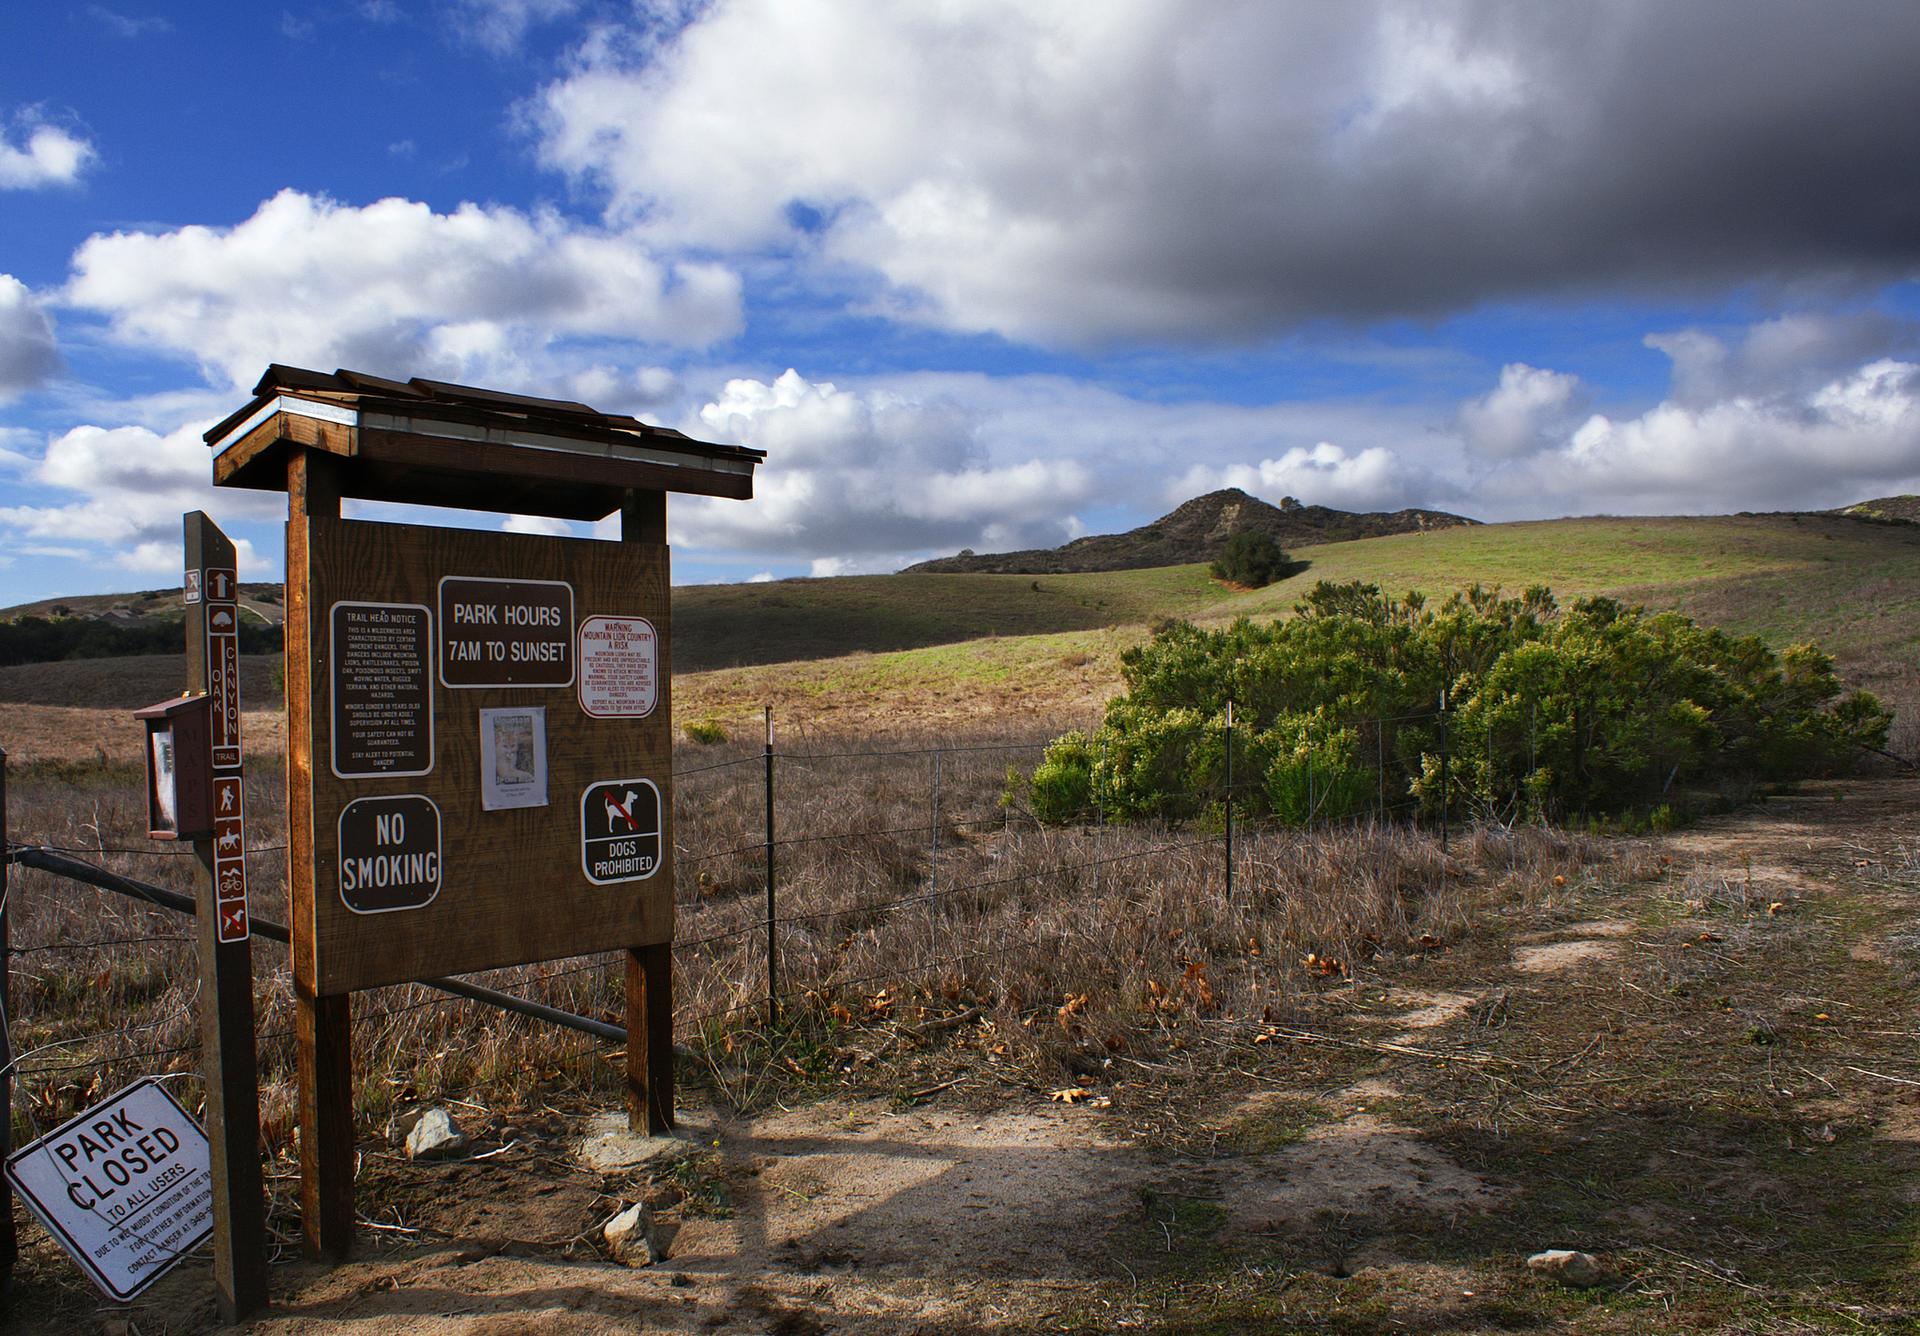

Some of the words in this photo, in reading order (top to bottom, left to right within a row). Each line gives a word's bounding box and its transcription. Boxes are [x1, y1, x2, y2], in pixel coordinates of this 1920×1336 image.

[347, 612, 368, 623] TRAIL
[369, 613, 390, 624] HEAD
[390, 614, 417, 625] NOTICE
[454, 603, 498, 625] PARK
[505, 605, 561, 627] HOURS
[605, 623, 632, 632] WARNING
[449, 641, 481, 661] 7AM
[486, 641, 505, 661] TO
[510, 641, 567, 662] SUNSET
[584, 631, 612, 640] MOUNTAIN
[613, 632, 626, 640] LION
[627, 632, 651, 642] COUNTRY
[608, 641, 614, 649] A
[615, 641, 629, 649] RISK
[212, 669, 222, 712] OAK
[226, 646, 238, 735] CANYON
[215, 752, 237, 761] TRAIL
[377, 812, 405, 846] NO
[594, 856, 653, 877] PROHIBITED
[609, 841, 637, 858] DOGS
[343, 851, 438, 890] SMOKING
[54, 1107, 144, 1172] PARK
[67, 1127, 180, 1210] CLOSED
[107, 1204, 126, 1220] TO
[126, 1189, 151, 1209] ALL
[147, 1163, 186, 1192] USERS
[94, 1244, 111, 1258] DUE
[108, 1237, 120, 1248] TO
[130, 1212, 153, 1232] MUDDY
[152, 1191, 184, 1217] CONDITION
[181, 1184, 192, 1196] OF
[190, 1177, 203, 1189] THE
[129, 1238, 145, 1252] FOR
[143, 1217, 174, 1240] FURTHER
[127, 1248, 158, 1274] CONTACT
[181, 1223, 192, 1234] AT
